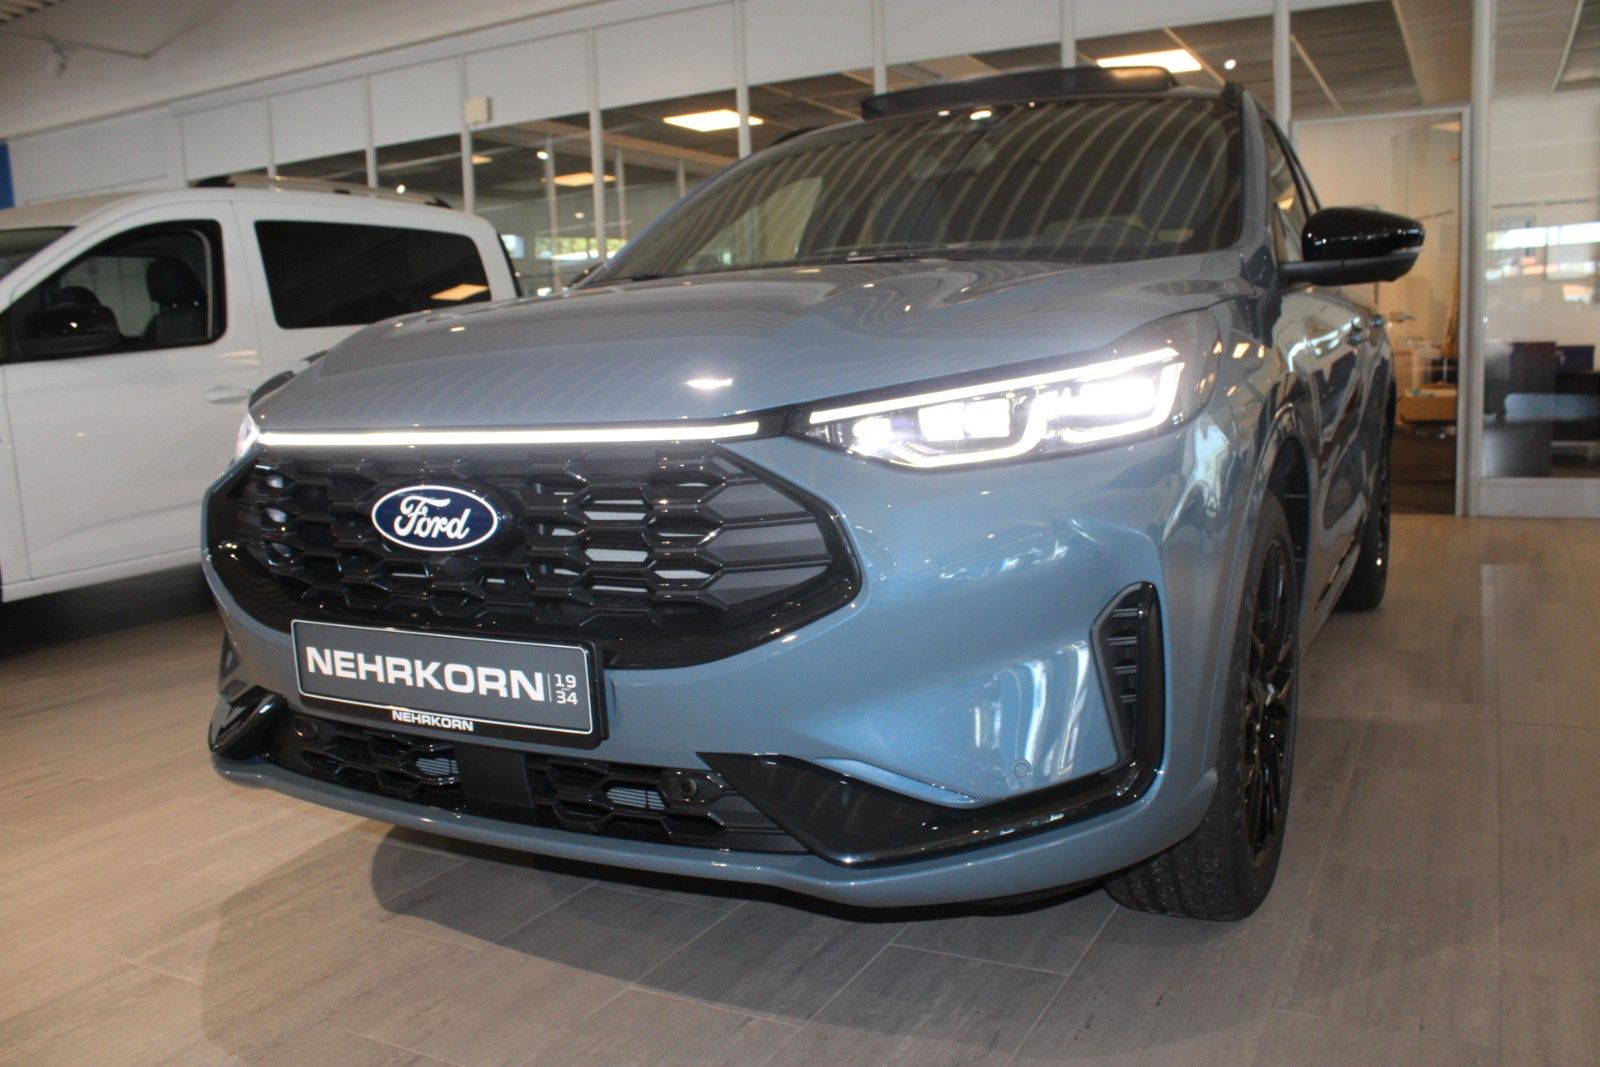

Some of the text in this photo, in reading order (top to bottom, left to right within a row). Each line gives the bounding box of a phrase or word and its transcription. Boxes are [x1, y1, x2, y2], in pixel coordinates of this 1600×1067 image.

[393, 495, 471, 539] Ford
[306, 646, 545, 702] NEHRKORN
[554, 673, 577, 688] 19
[556, 690, 578, 705] 34
[392, 709, 474, 732] NEHRKORN
